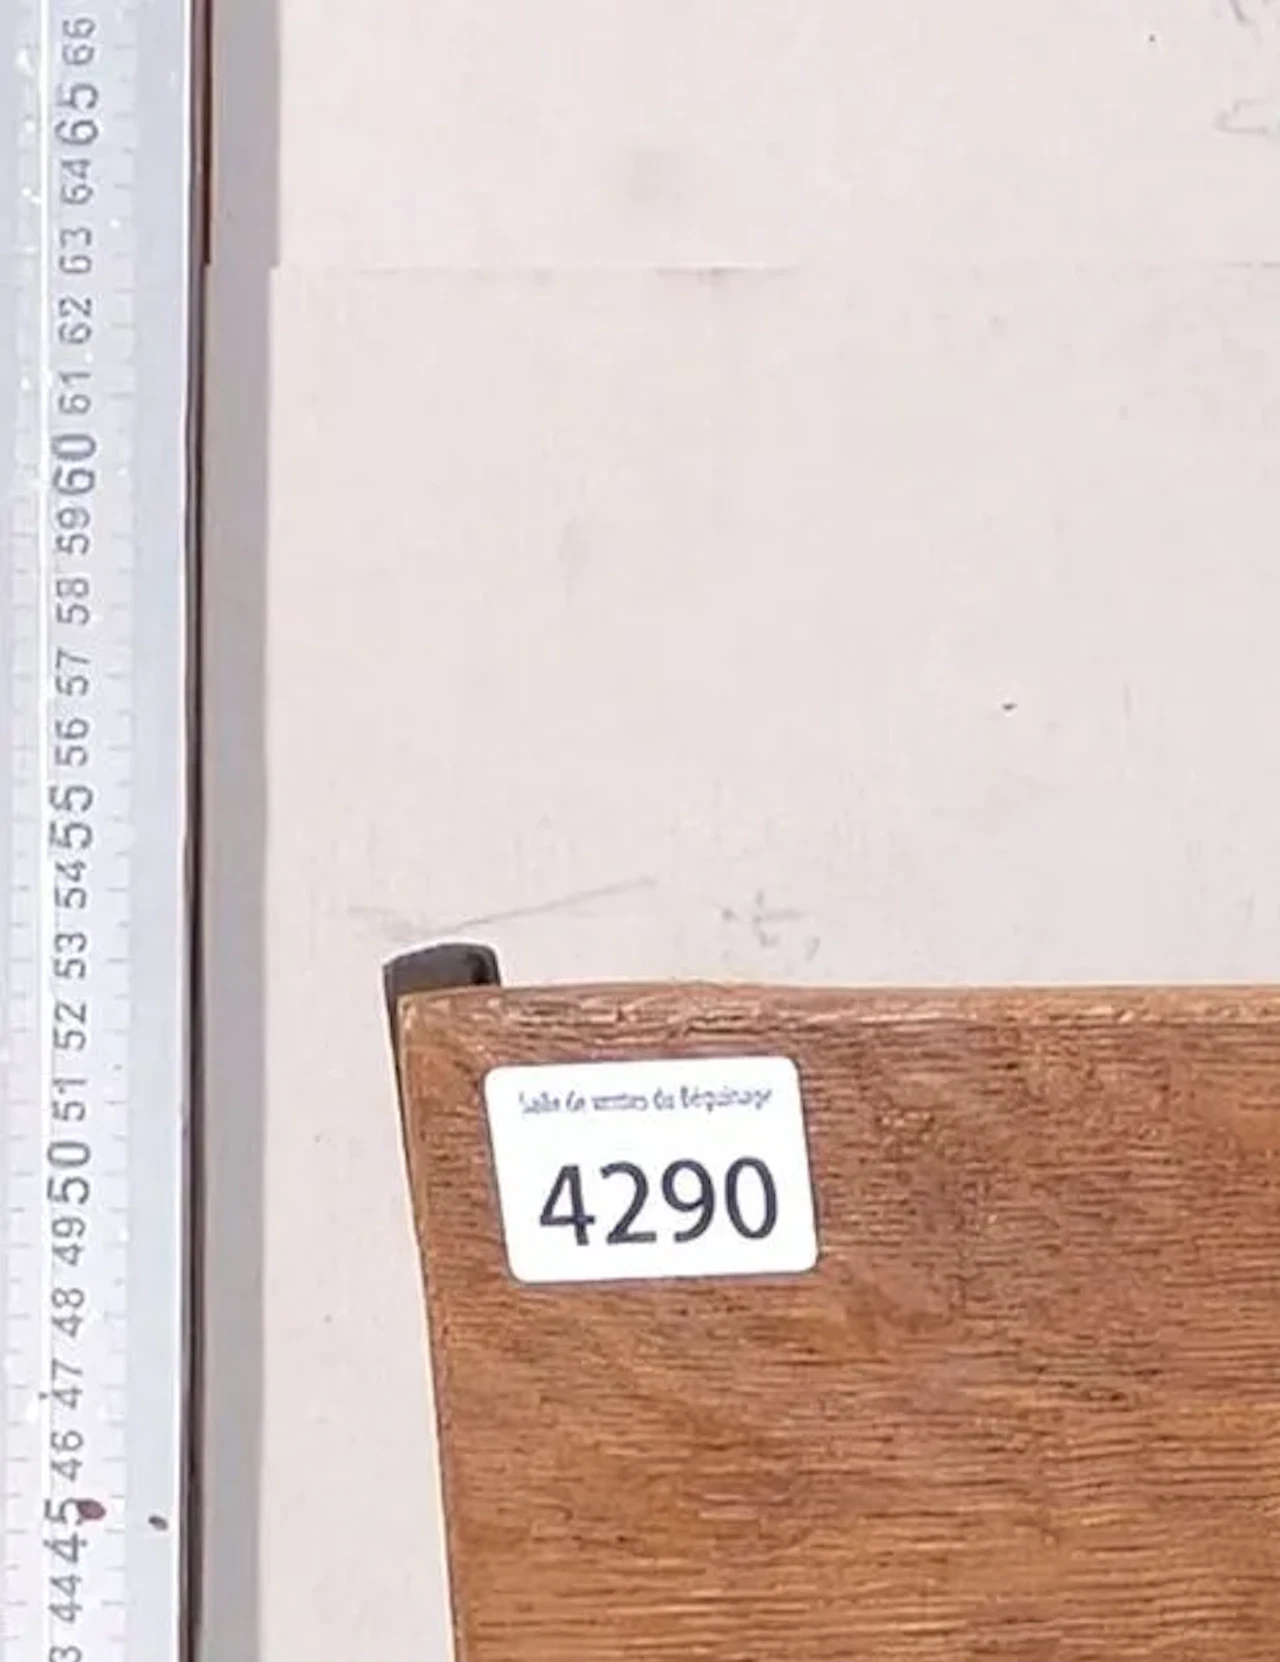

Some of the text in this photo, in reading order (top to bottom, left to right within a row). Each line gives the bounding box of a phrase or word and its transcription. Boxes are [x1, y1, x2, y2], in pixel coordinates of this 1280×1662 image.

[61, 17, 96, 67] 66
[53, 82, 100, 147] 65
[59, 158, 95, 206] 64
[58, 226, 93, 275] 63
[57, 296, 93, 346] 62
[57, 371, 92, 416] 61
[49, 433, 98, 497] 60
[53, 506, 91, 556] 59
[55, 577, 91, 627] 58
[54, 646, 91, 697] 57
[53, 717, 90, 767] 56
[47, 784, 95, 851] 55
[53, 859, 88, 910] 54
[52, 931, 88, 981] 53
[51, 999, 88, 1053] 52
[50, 1077, 88, 1123] 51
[45, 1139, 92, 1206] 50
[539, 1155, 778, 1247] 4290
[50, 1215, 87, 1268] 49
[49, 1286, 86, 1339] 48
[49, 1356, 84, 1411] 47
[49, 1429, 85, 1483] 46
[41, 1496, 89, 1566] 45
[47, 1572, 84, 1625] 44
